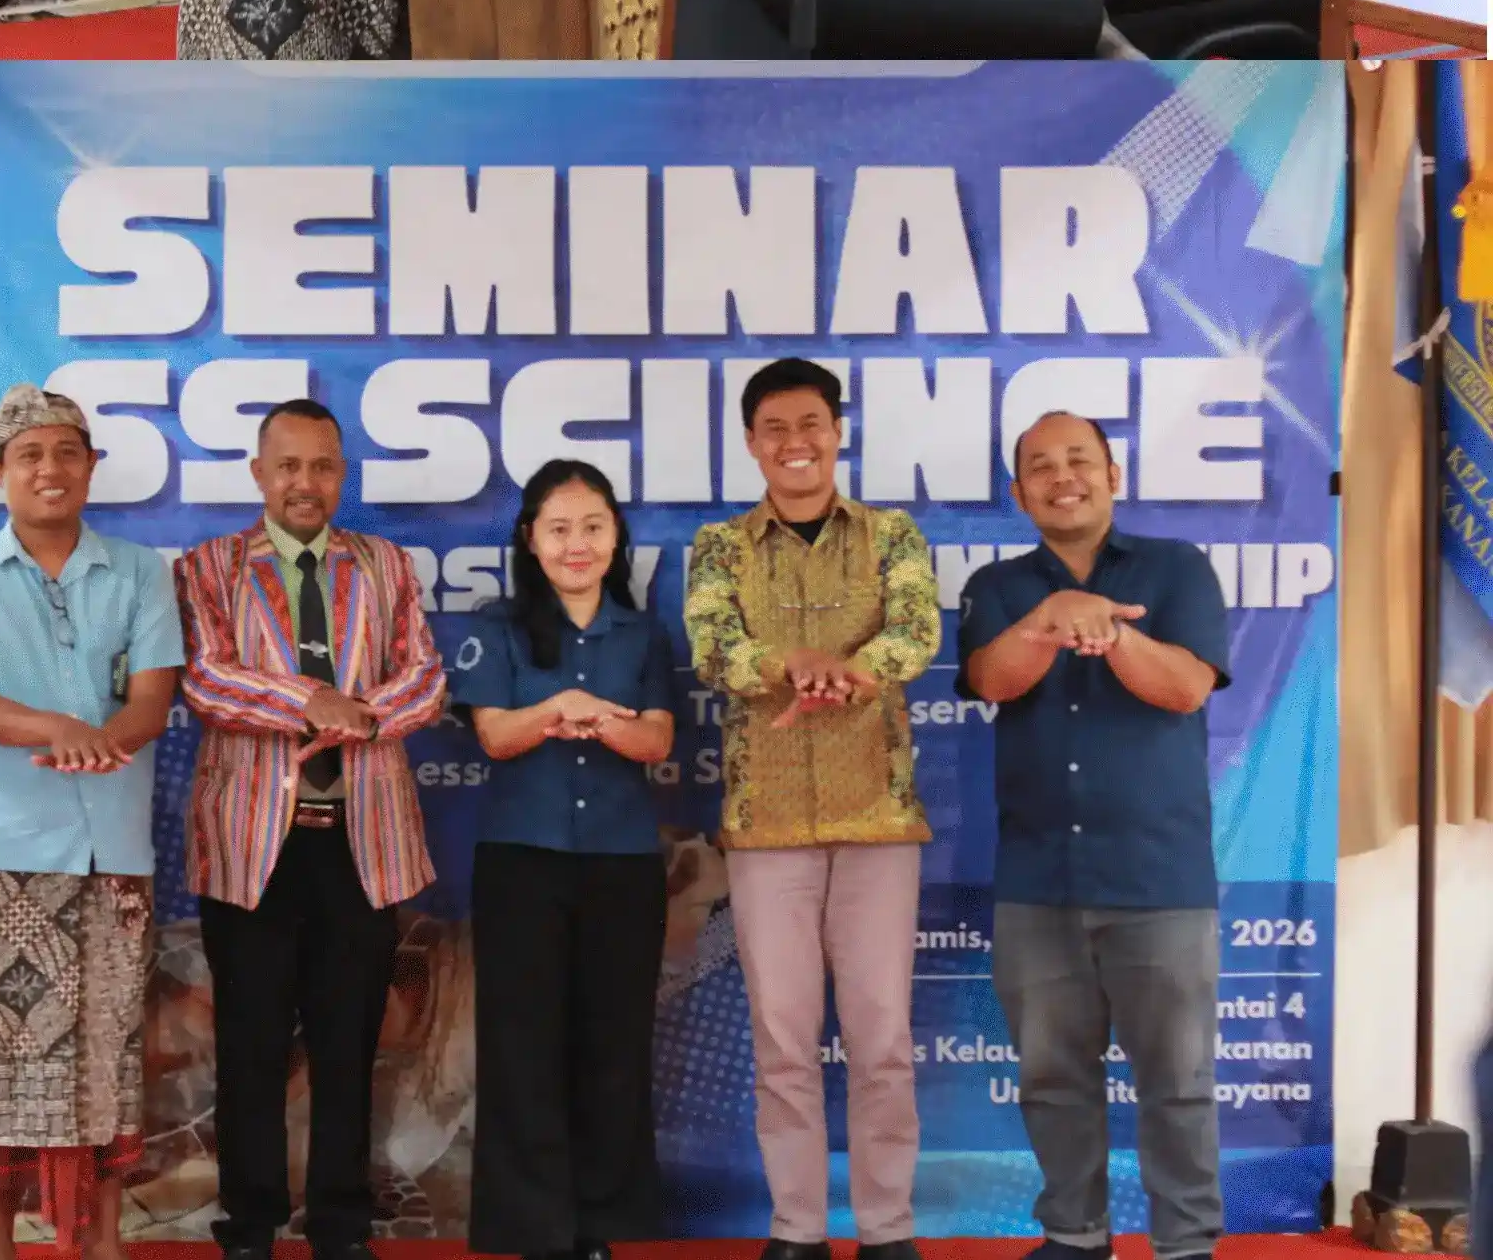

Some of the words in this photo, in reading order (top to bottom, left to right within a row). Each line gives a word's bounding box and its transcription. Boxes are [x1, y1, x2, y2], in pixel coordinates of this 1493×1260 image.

[58, 167, 1149, 338] SEMINAR
[913, 924, 992, 953] amis,
[1231, 920, 1317, 947] 2026
[1283, 994, 1306, 1019] 4
[1214, 1083, 1310, 1110] ayana
